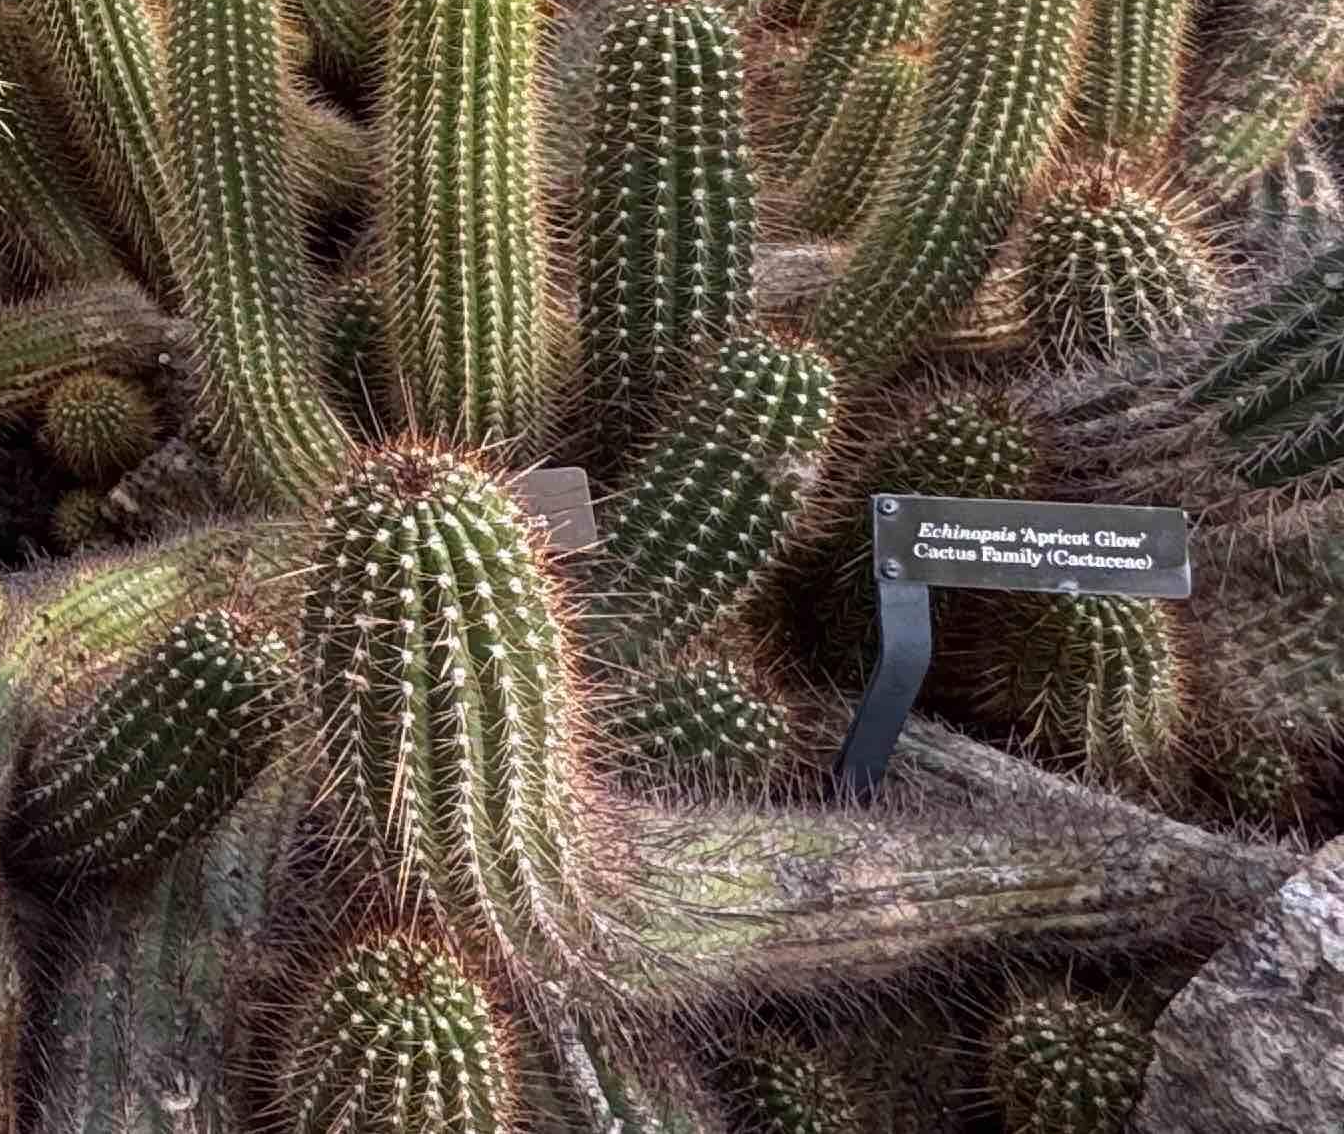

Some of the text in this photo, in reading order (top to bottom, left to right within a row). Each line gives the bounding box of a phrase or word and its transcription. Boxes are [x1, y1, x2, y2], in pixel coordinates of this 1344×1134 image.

[918, 522, 1016, 544] Echinopsis
[913, 543, 1153, 570] Cactus Family (Cactaceae)
